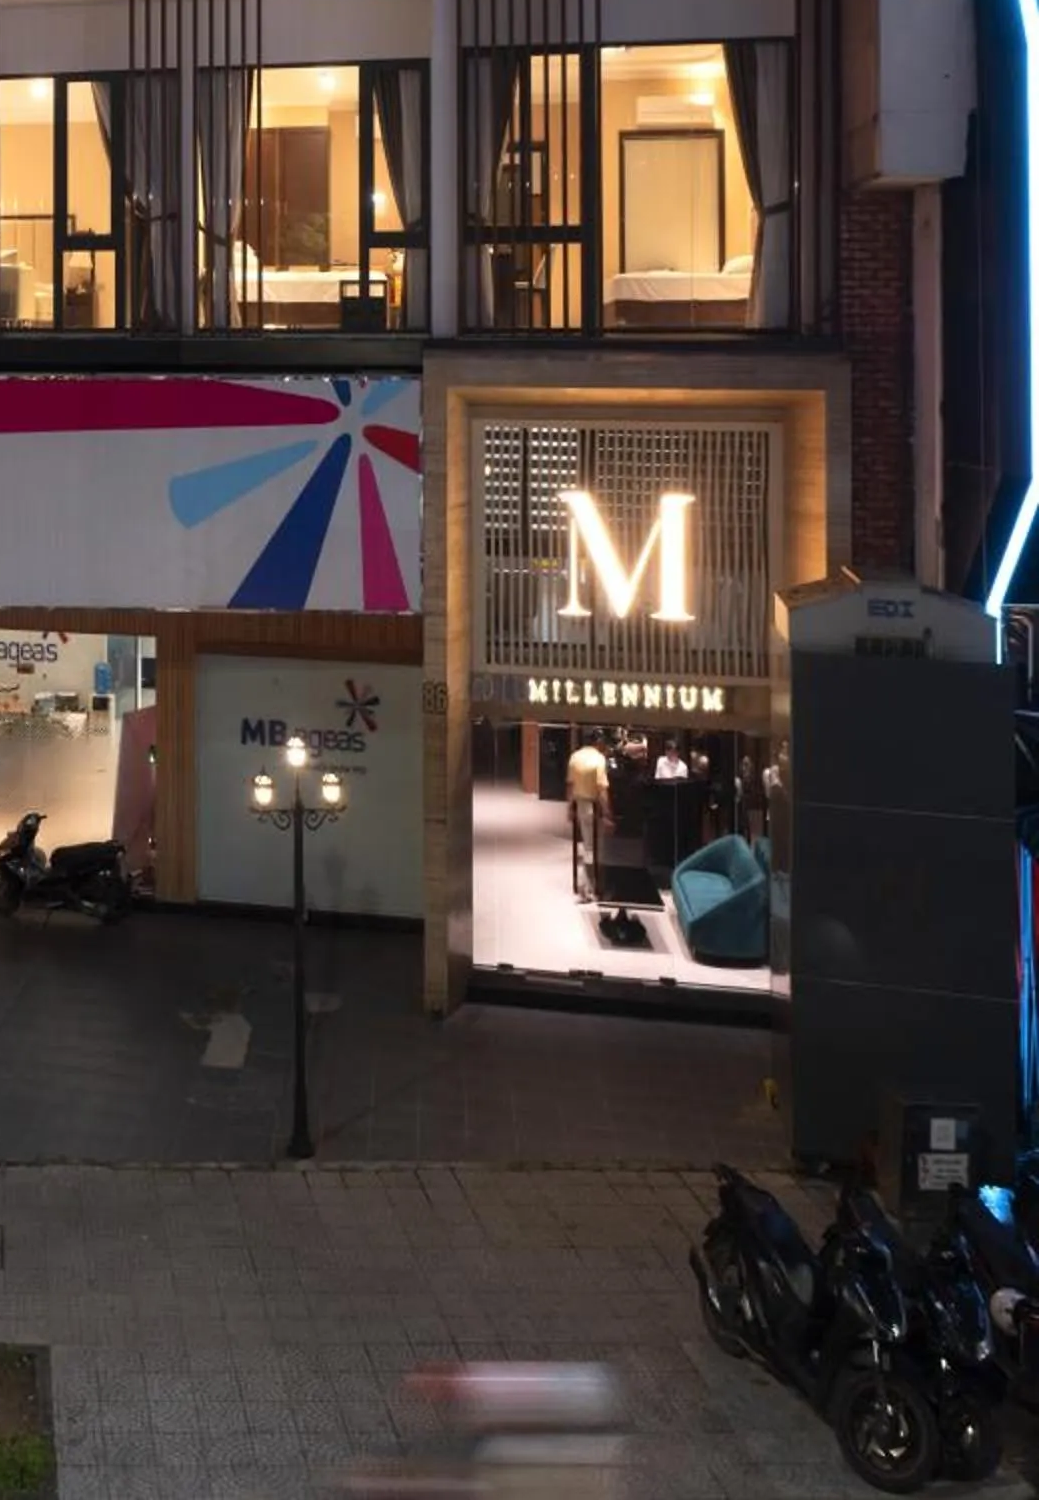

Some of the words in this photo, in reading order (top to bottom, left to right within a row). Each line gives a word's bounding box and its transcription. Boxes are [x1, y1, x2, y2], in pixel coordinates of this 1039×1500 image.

[558, 490, 697, 622] M
[528, 677, 725, 712] MILLENNIUM
[240, 717, 287, 747] MB
